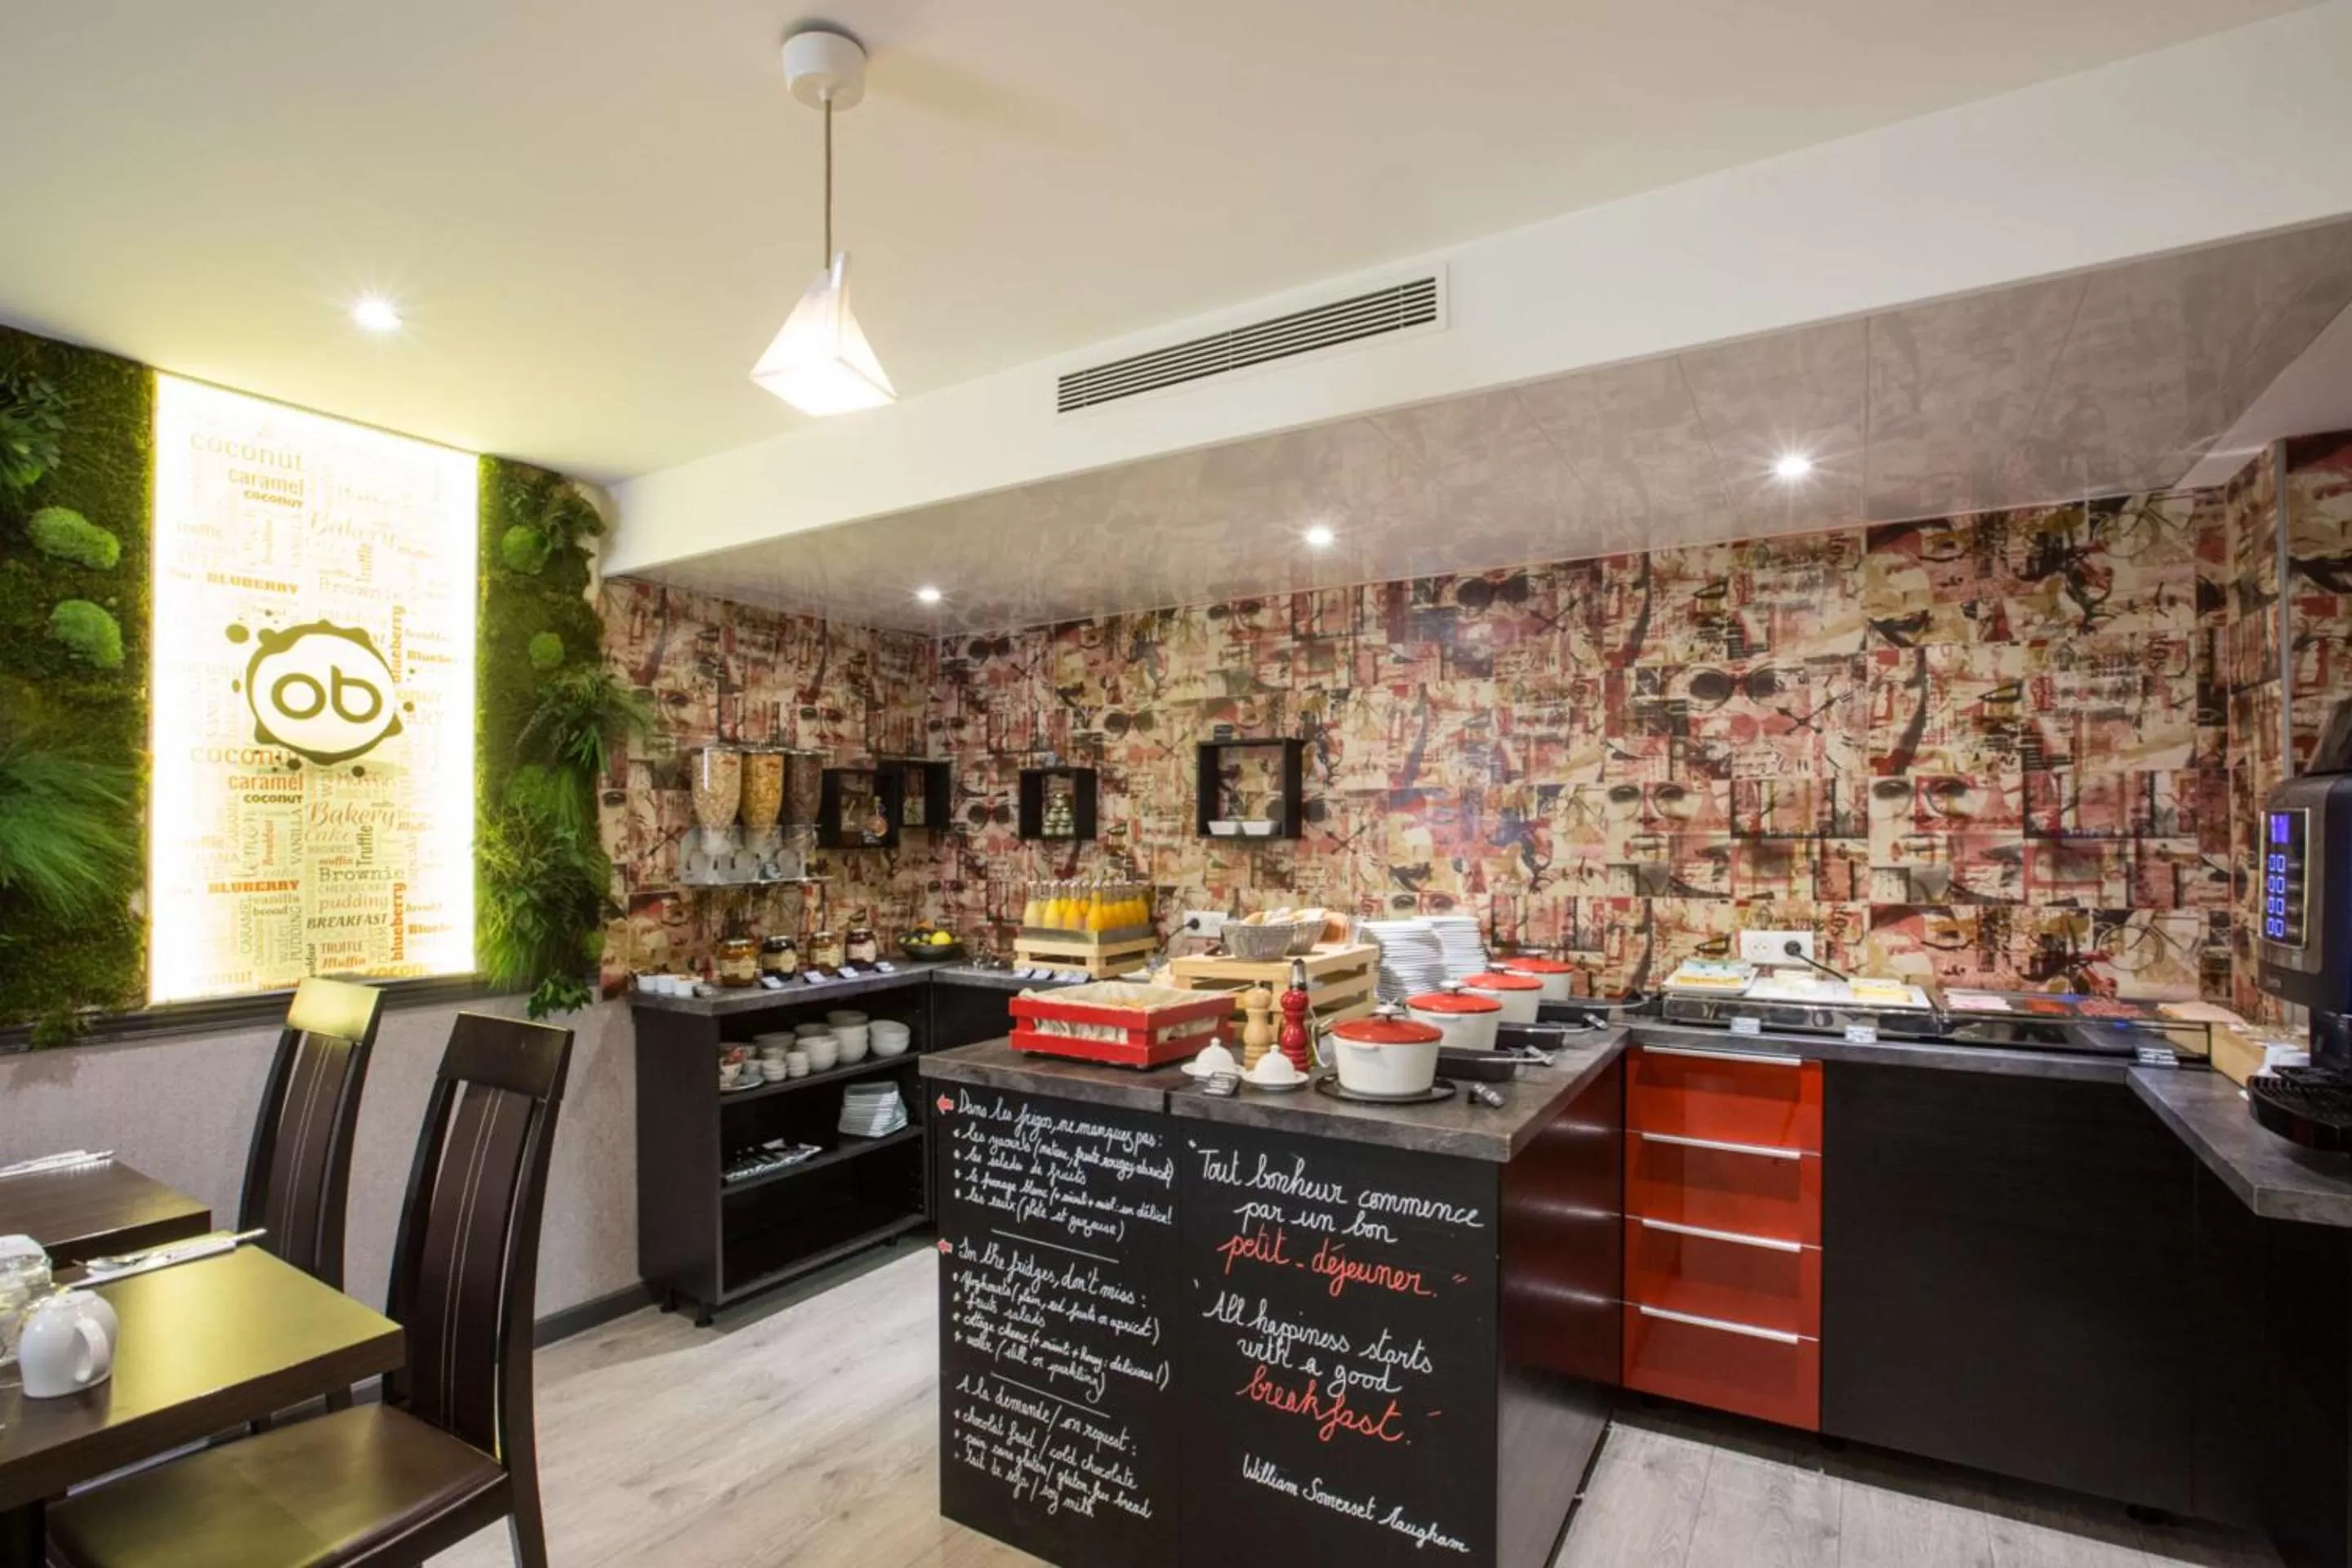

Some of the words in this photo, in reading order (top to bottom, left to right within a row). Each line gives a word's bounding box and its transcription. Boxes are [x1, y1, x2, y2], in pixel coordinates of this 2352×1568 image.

[189, 432, 307, 471] coconut
[227, 467, 305, 497] caramel
[228, 773, 304, 791] caramel
[243, 793, 304, 804] coconut
[309, 800, 397, 831] Bakery
[356, 825, 374, 867] Truffle
[318, 866, 406, 883] Brownie
[305, 913, 390, 930] BREAKFAST
[389, 881, 408, 962] blueberry
[988, 1095, 1013, 1122] les
[961, 1120, 986, 1143] les
[1245, 1152, 1348, 1205] bonheur
[1357, 1188, 1486, 1227] commence
[1233, 1201, 1286, 1234] par
[1290, 1209, 1336, 1232] un
[1342, 1209, 1399, 1244] bon
[979, 1241, 1006, 1271] the
[1061, 1261, 1101, 1296] don't
[1247, 1298, 1351, 1352] happiness
[1358, 1328, 1434, 1374] starts
[1236, 1334, 1293, 1369] with
[1298, 1356, 1325, 1377] a
[1326, 1360, 1404, 1398] good
[1242, 1453, 1298, 1497] William
[1302, 1477, 1377, 1521] Somerset
